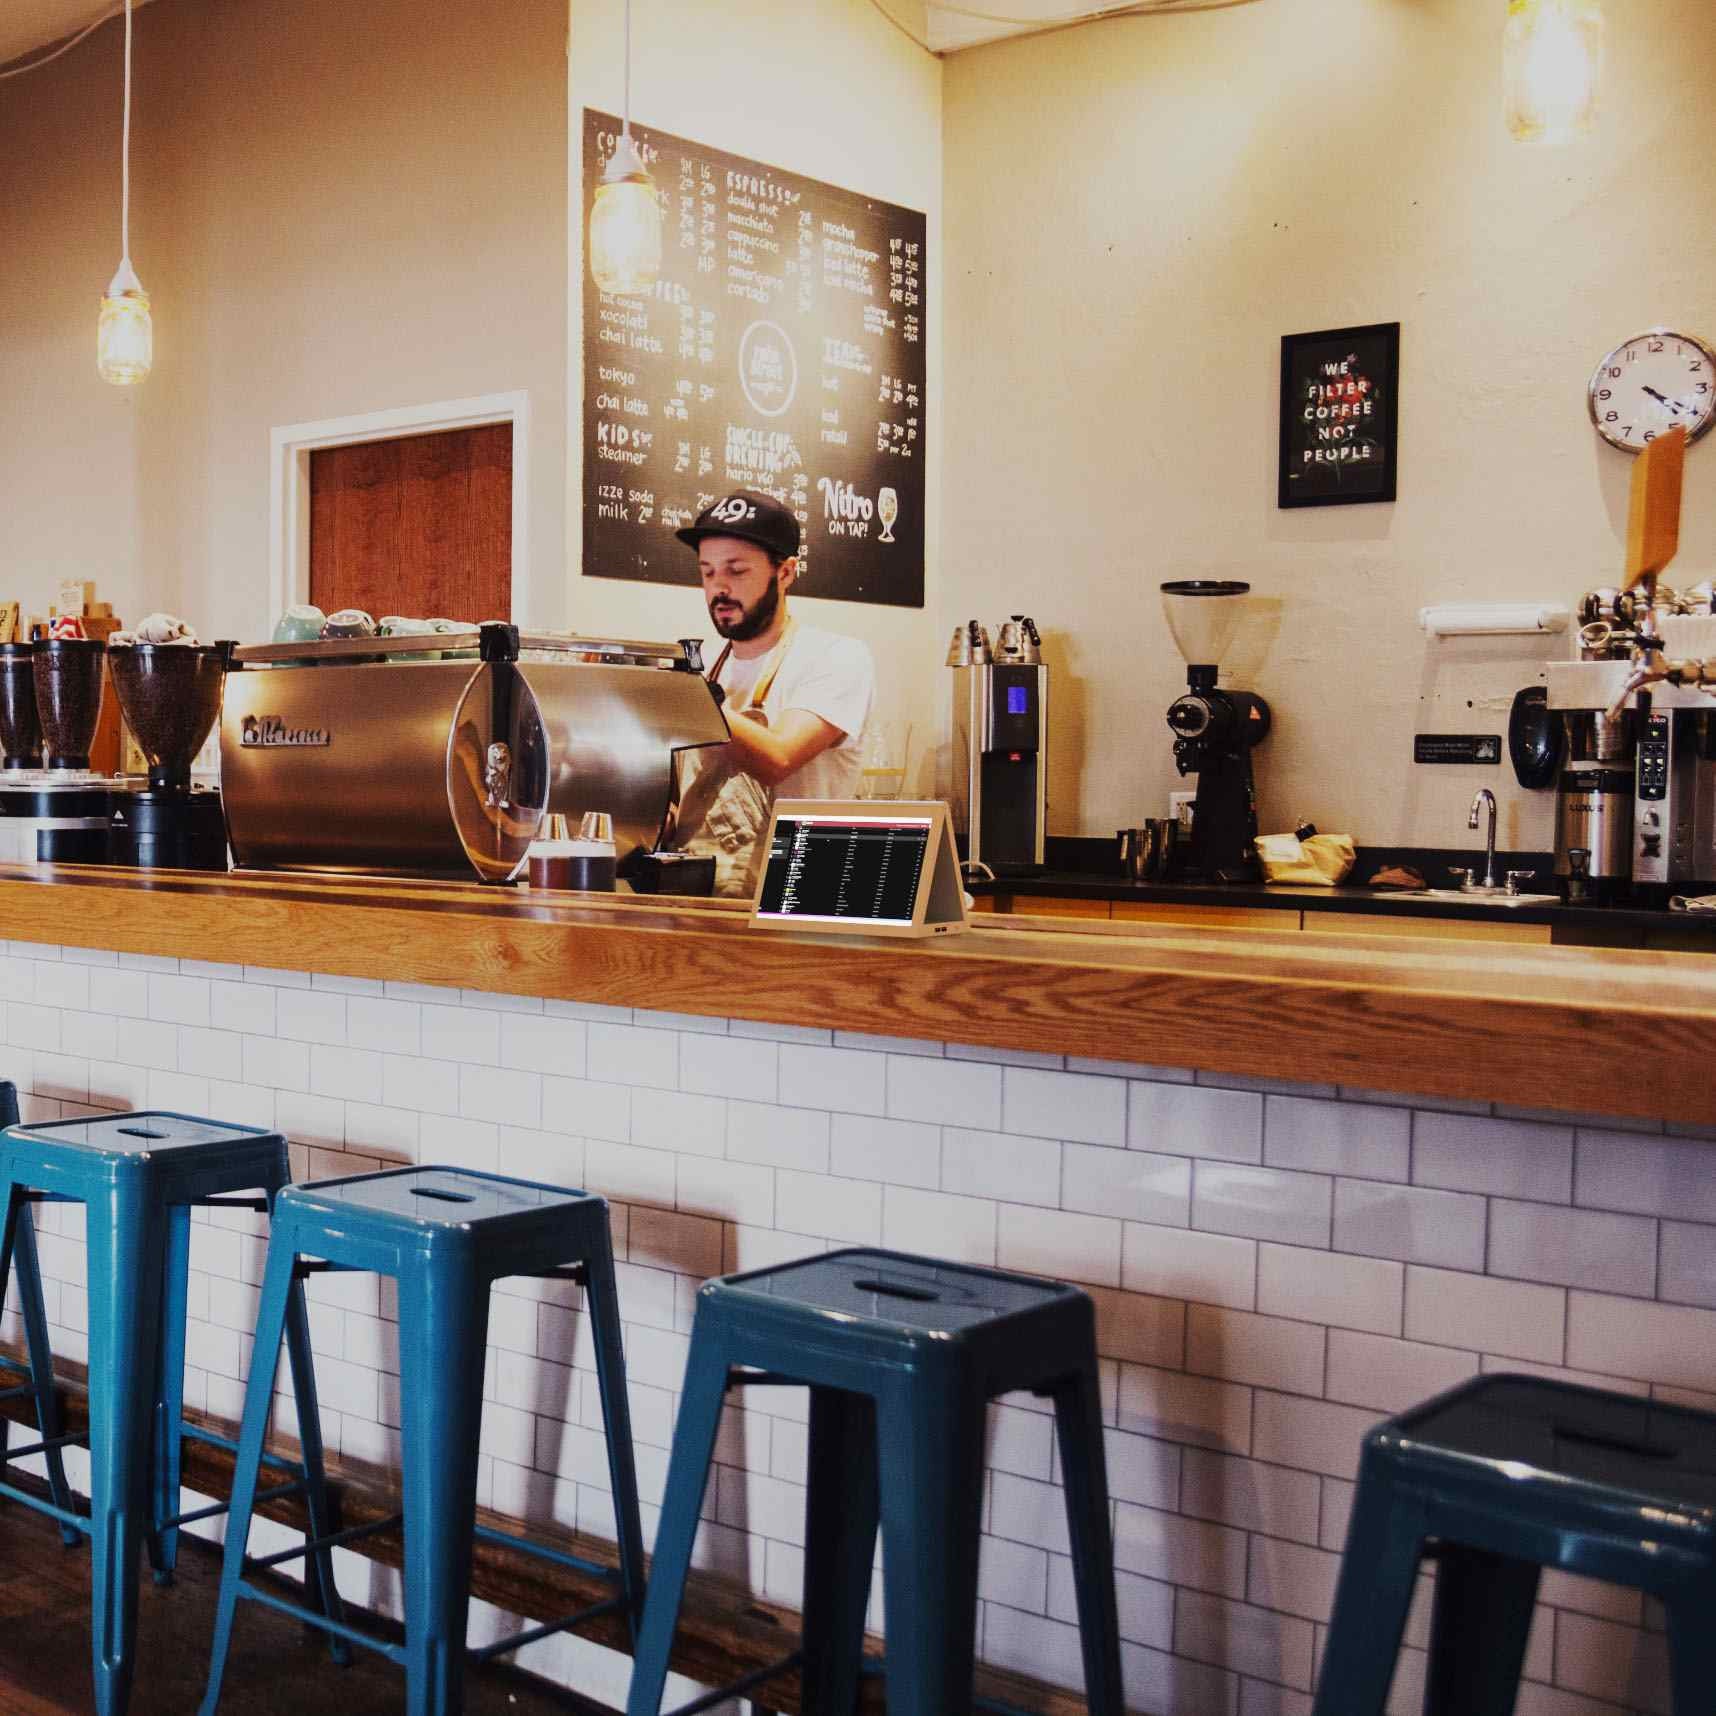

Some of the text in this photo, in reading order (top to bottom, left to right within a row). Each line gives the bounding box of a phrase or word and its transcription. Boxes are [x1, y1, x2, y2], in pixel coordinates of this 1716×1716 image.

[1648, 341, 1664, 353] 12
[1626, 351, 1636, 362] 11
[1325, 362, 1349, 376] WE
[1608, 367, 1621, 378] 10
[1689, 360, 1702, 372] 2
[598, 365, 635, 387] tokyo
[1308, 381, 1367, 399] FILTER
[1599, 389, 1612, 400] 9
[1696, 382, 1708, 394] 3
[1304, 401, 1372, 420] COFFEE
[1605, 410, 1619, 422] 8
[1318, 425, 1356, 440] NOT
[1622, 426, 1633, 438] 7
[598, 445, 649, 465] steamer
[1303, 445, 1371, 462] PEOPLE
[628, 489, 654, 505] soda
[598, 502, 629, 521] milk
[828, 521, 869, 538] ON TAP!
